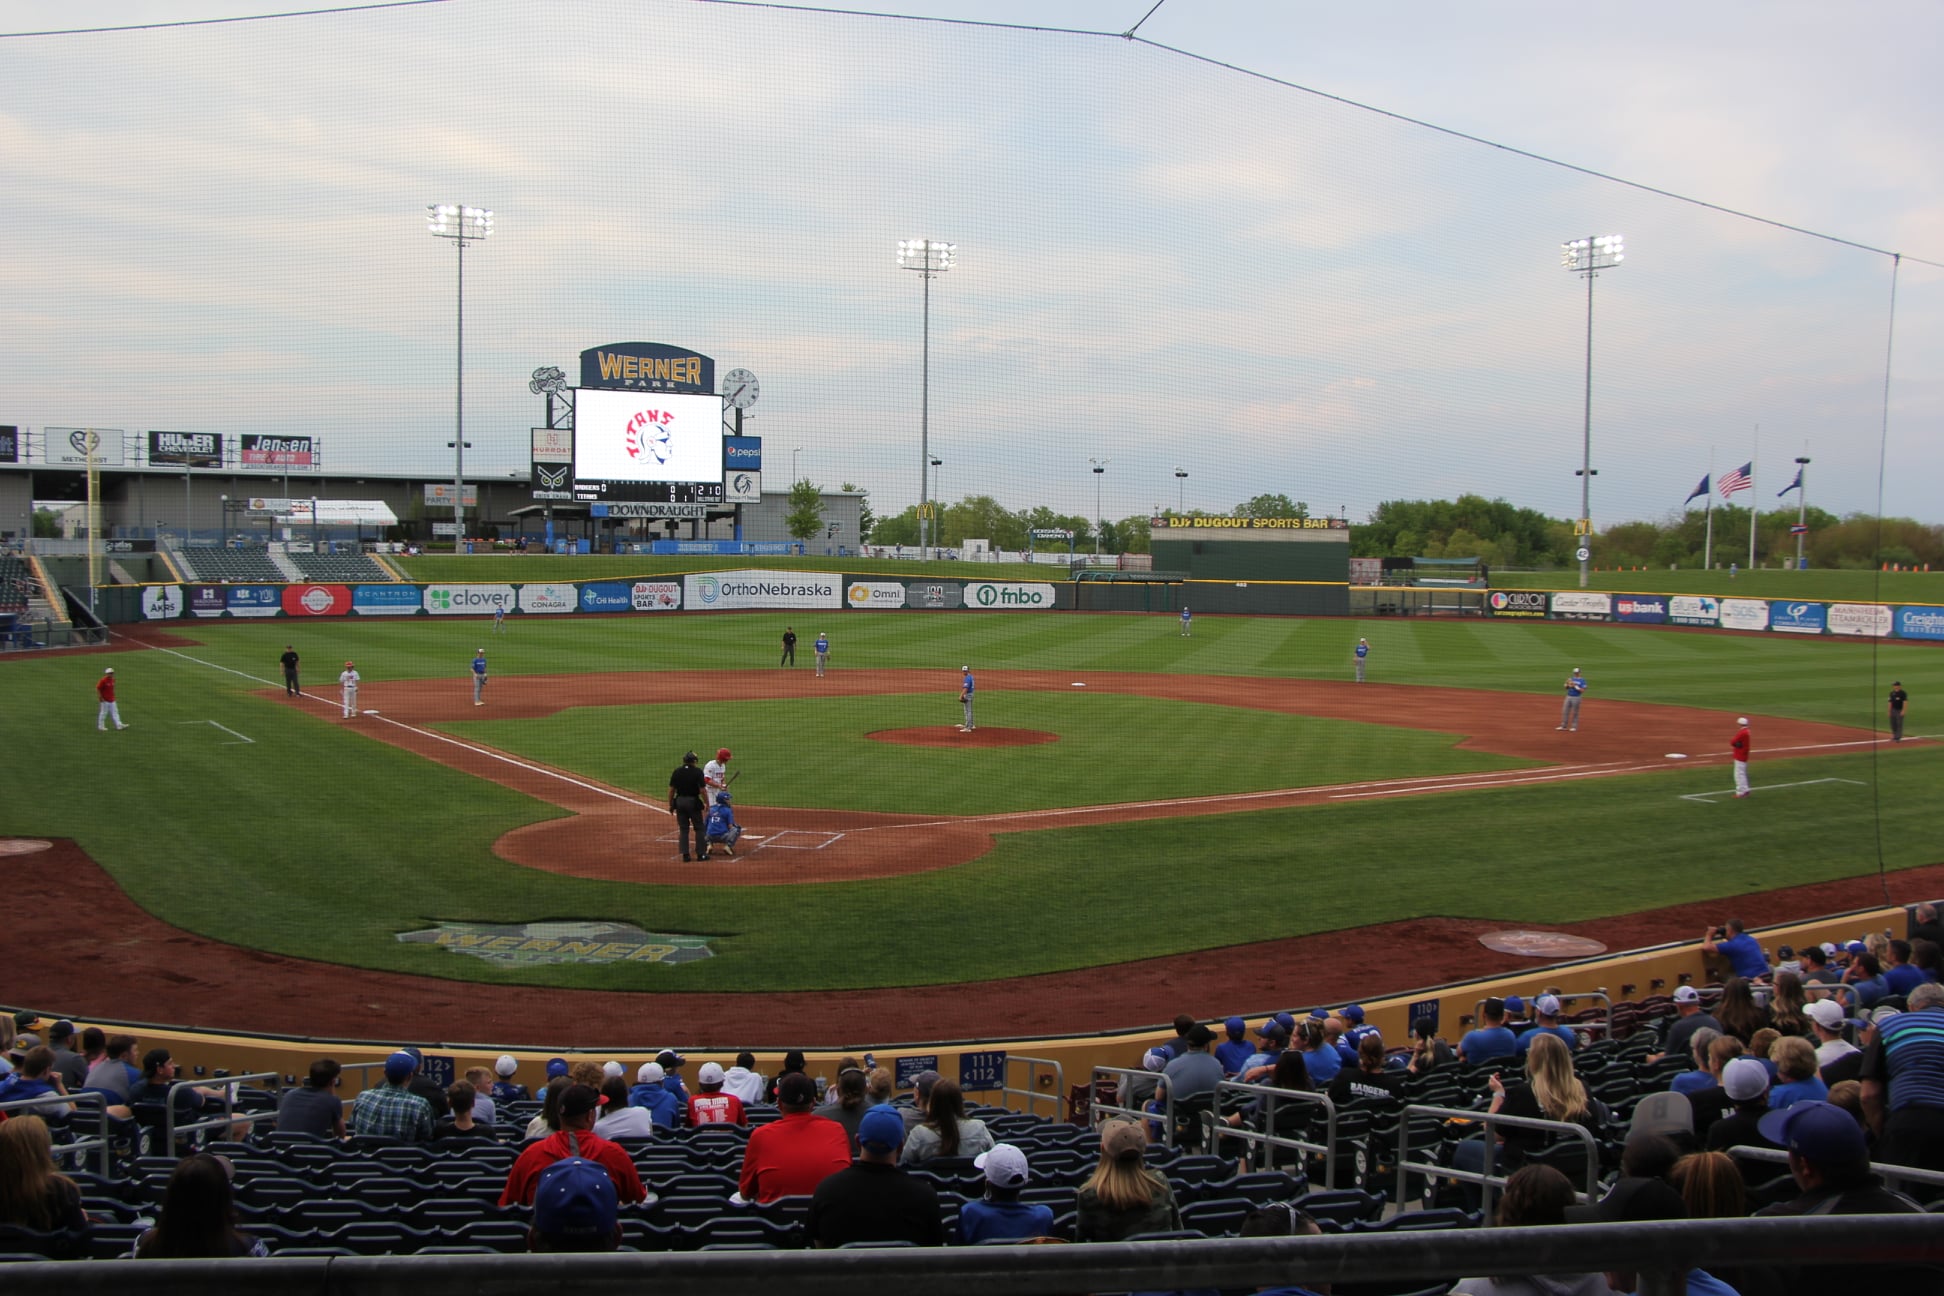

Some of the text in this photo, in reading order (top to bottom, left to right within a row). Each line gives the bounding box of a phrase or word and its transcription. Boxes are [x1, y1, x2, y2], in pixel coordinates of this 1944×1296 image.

[598, 351, 702, 386] WERNER
[624, 380, 676, 388] PARK
[626, 409, 675, 458] TITANS
[251, 435, 310, 452] Jensen
[738, 448, 761, 457] pepsi
[698, 486, 704, 495] 2
[715, 487, 721, 495] 0
[611, 504, 706, 517] DOWNDRAUGHT
[1194, 518, 1249, 528] DUGOUT
[1253, 519, 1300, 529] SPORTS
[1304, 520, 1329, 529] BAR
[649, 585, 677, 593] DUGOUT
[722, 583, 832, 596] OrthoNebraska
[1000, 587, 1042, 604] fnbo
[453, 589, 510, 605] clover
[608, 597, 628, 605] Health
[434, 931, 678, 962] WERNER
[972, 1055, 993, 1067] 111
[971, 1068, 994, 1081] 112
[1350, 1082, 1390, 1096] BADGERS
